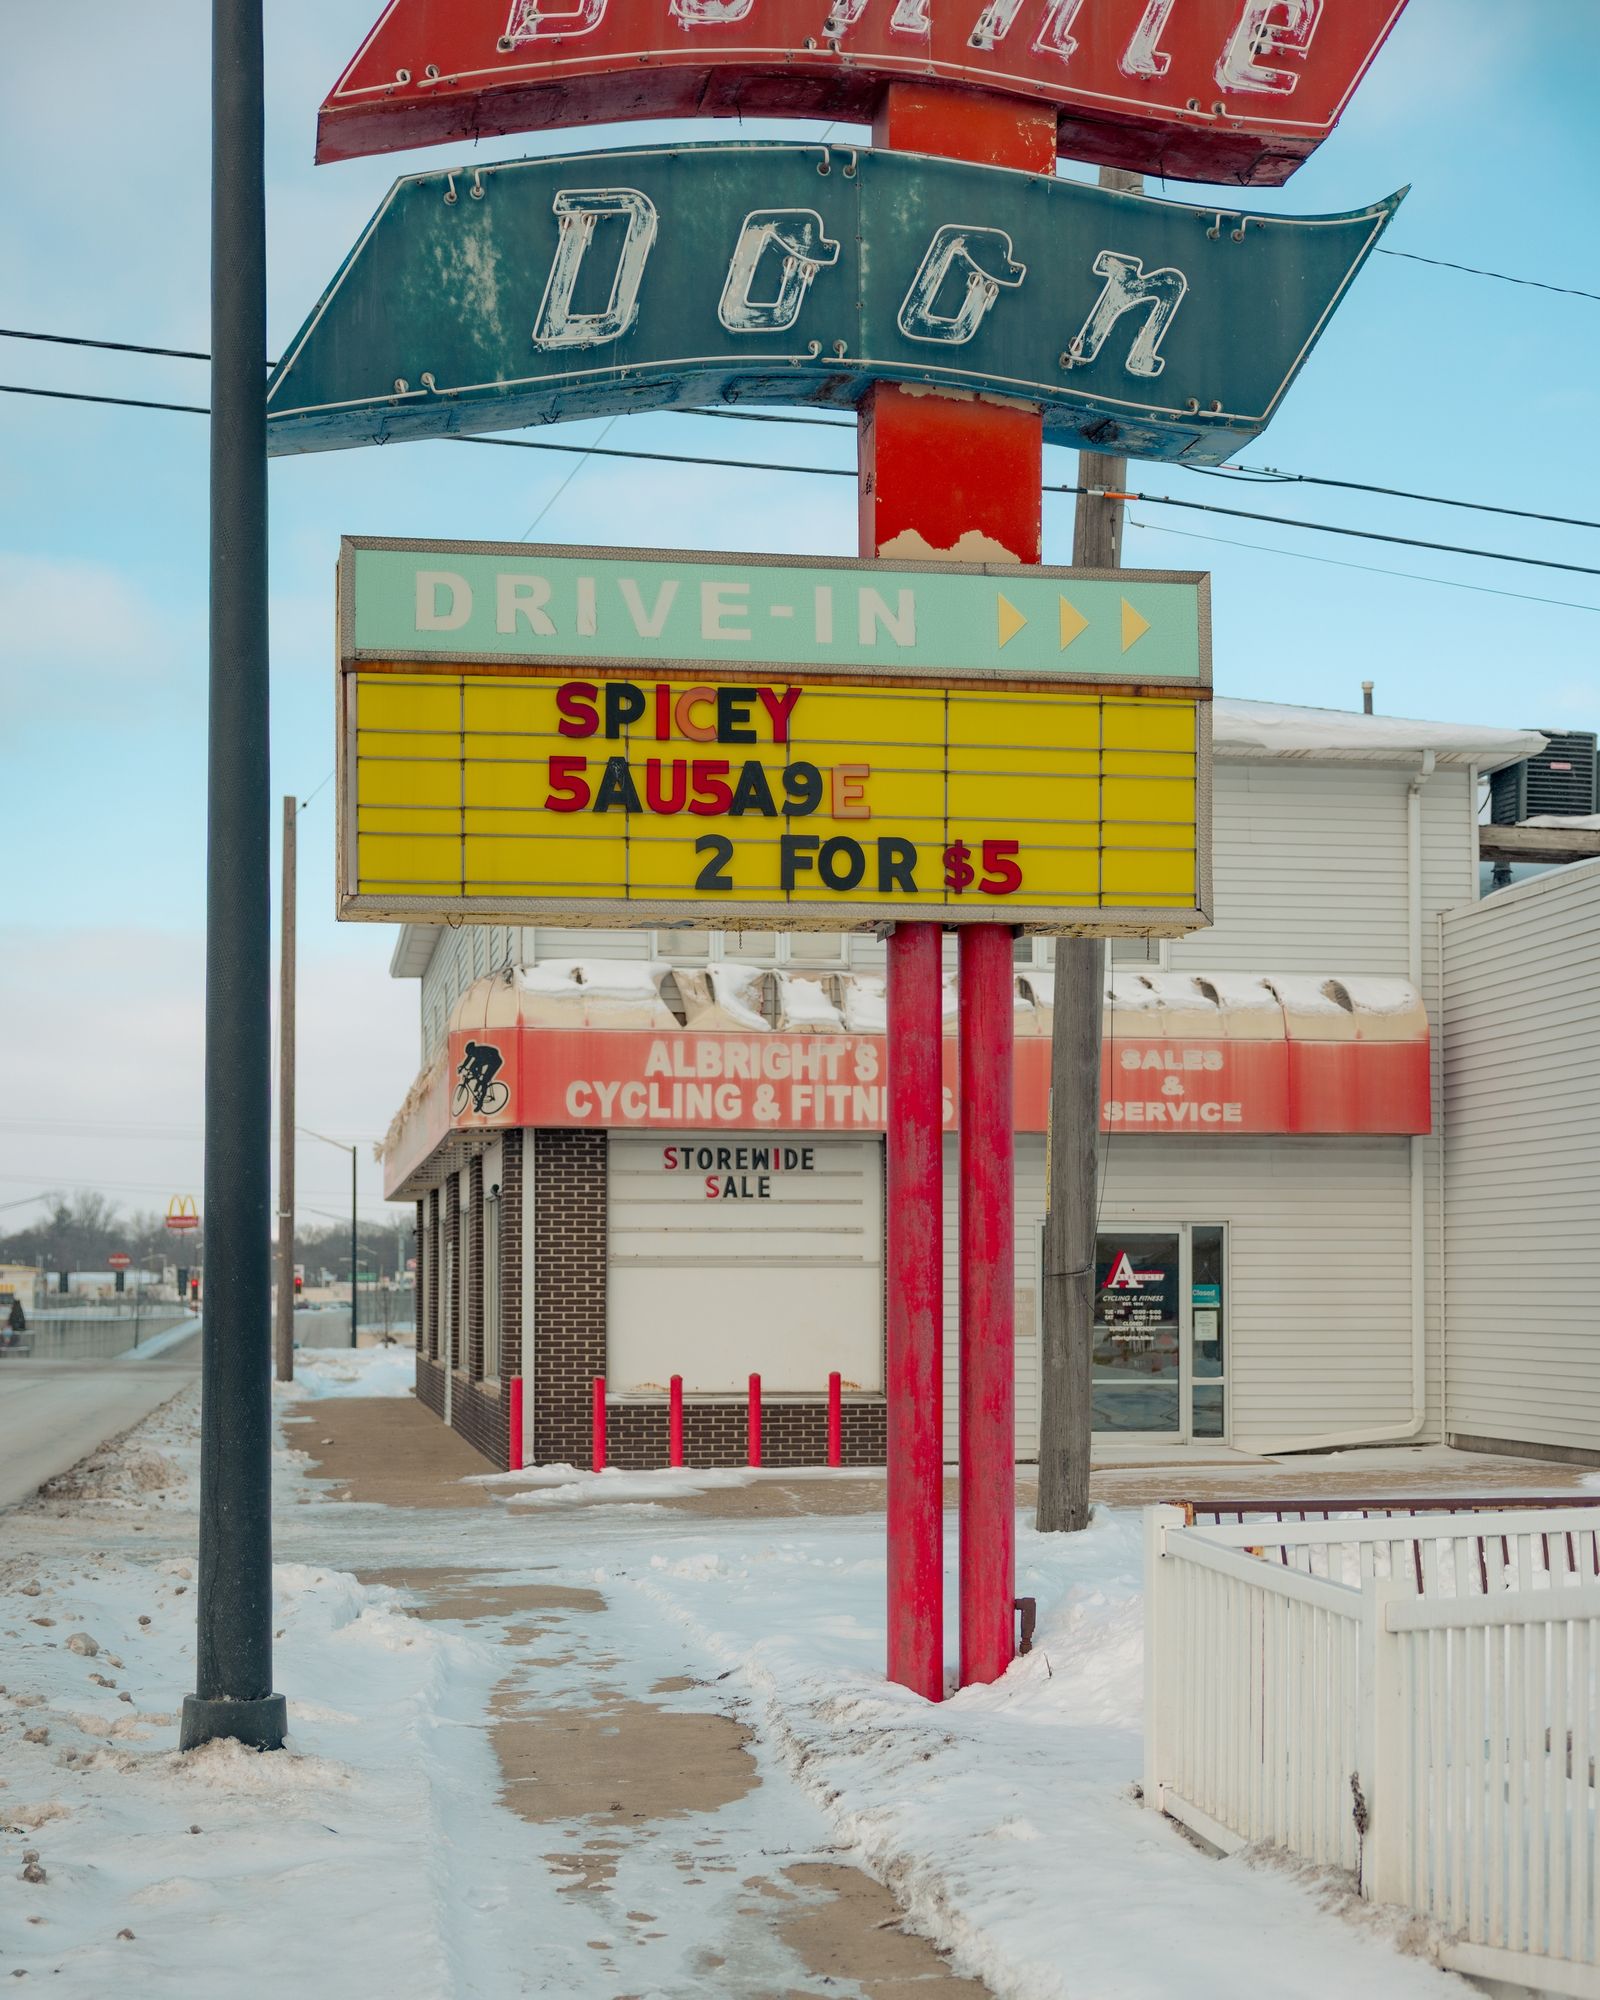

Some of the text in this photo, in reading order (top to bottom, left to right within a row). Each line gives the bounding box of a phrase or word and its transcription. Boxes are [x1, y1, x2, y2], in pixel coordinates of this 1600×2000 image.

[414, 570, 918, 648] DRIVE-IN
[556, 681, 803, 744] SPICEY
[694, 833, 1023, 895] 2 FOR $5
[644, 1040, 879, 1082] ALBRIGHT'S
[1120, 1049, 1224, 1071] SALES
[1161, 1075, 1185, 1096] &
[565, 1080, 743, 1120] CYCLING
[752, 1083, 782, 1121] &
[1103, 1101, 1243, 1122] SERVICE
[663, 1146, 815, 1171] STOREWIDE
[704, 1174, 772, 1199] SALE
[1192, 1289, 1216, 1297] Closed
